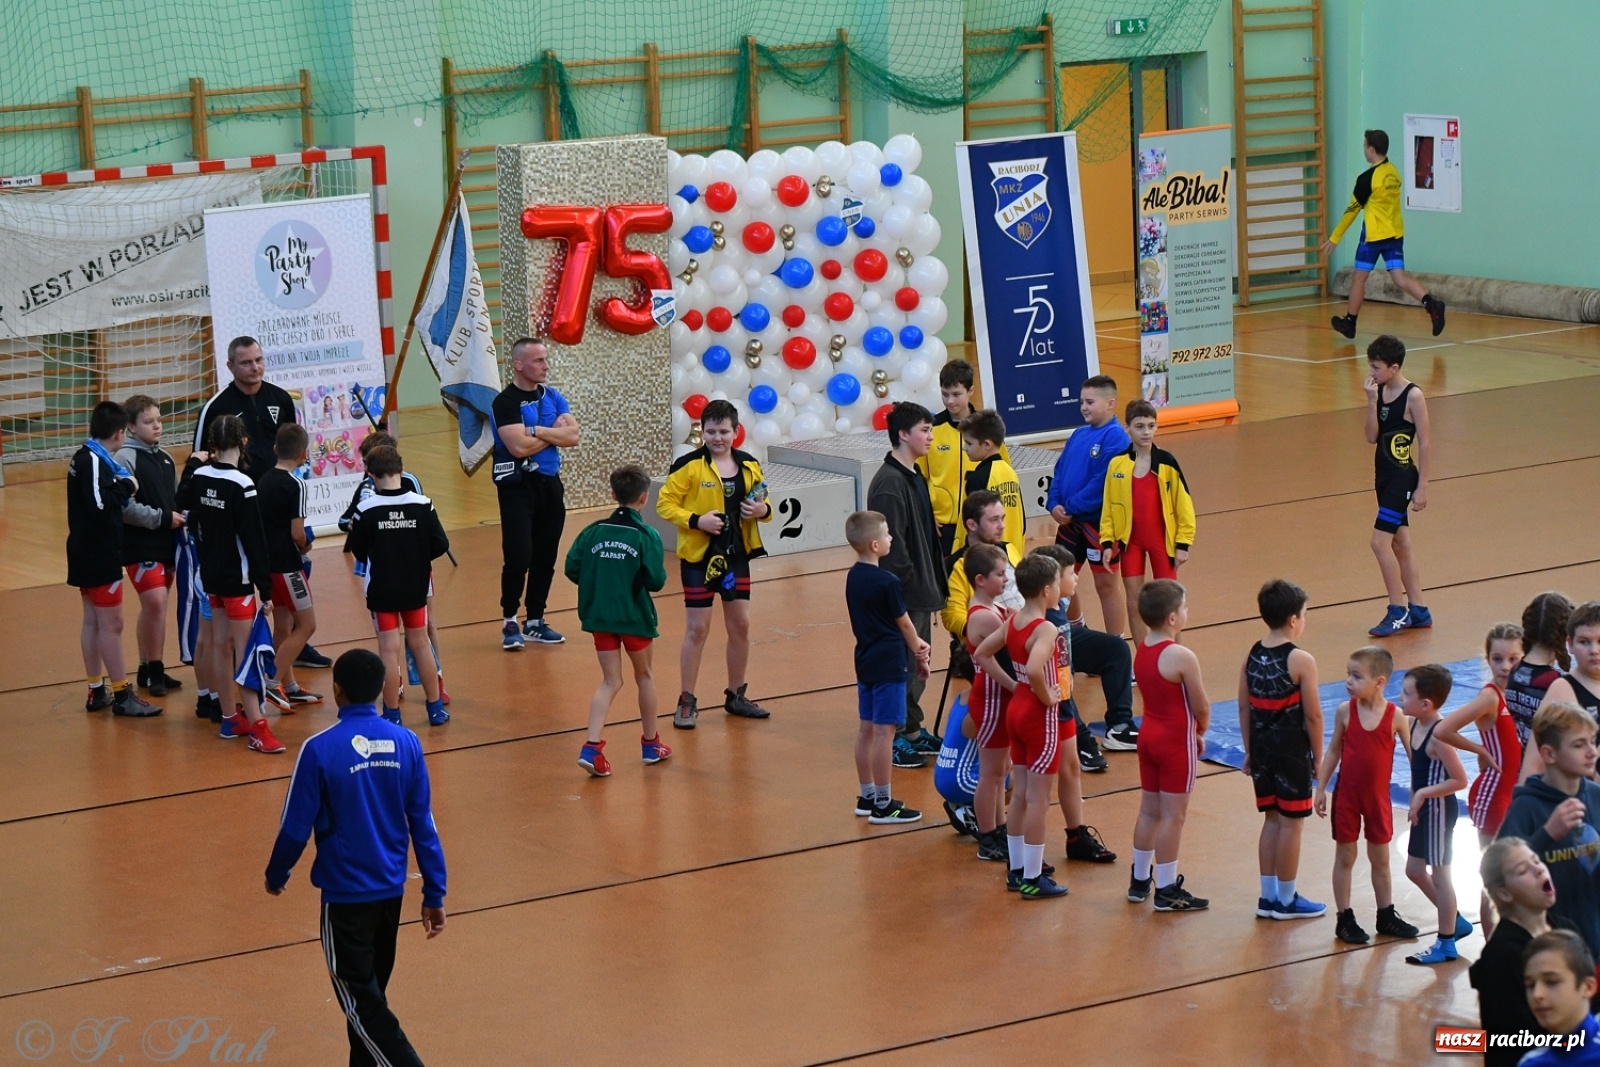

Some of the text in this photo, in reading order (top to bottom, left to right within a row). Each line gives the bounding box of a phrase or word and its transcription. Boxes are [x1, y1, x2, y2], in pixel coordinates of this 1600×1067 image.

[998, 163, 1040, 175] RACIBÓRZ
[999, 183, 1023, 194] MKZ
[1002, 192, 1043, 223] UNIA
[1169, 207, 1228, 221] PARTY SERWIS
[288, 237, 308, 254] My
[521, 202, 673, 345] 75
[19, 269, 73, 312] JEST
[79, 257, 105, 283] W
[281, 272, 308, 295] Shop
[257, 310, 342, 333] ZACZAROWANE MIEJSCE
[283, 330, 309, 346] CIESZY
[311, 328, 326, 342] OKO
[334, 324, 356, 339] SERCE
[445, 327, 473, 367] KLUB
[1030, 337, 1056, 357] lat
[1171, 343, 1232, 364] 792 972 352
[287, 352, 298, 364] NA
[495, 463, 514, 472] PUMA
[313, 482, 331, 500] 713
[388, 511, 405, 520] SIŁA
[779, 497, 804, 540] 2
[378, 520, 417, 530] MYSŁOWICE
[600, 551, 627, 560] ZAPASY
[604, 540, 639, 558] KATOWICE
